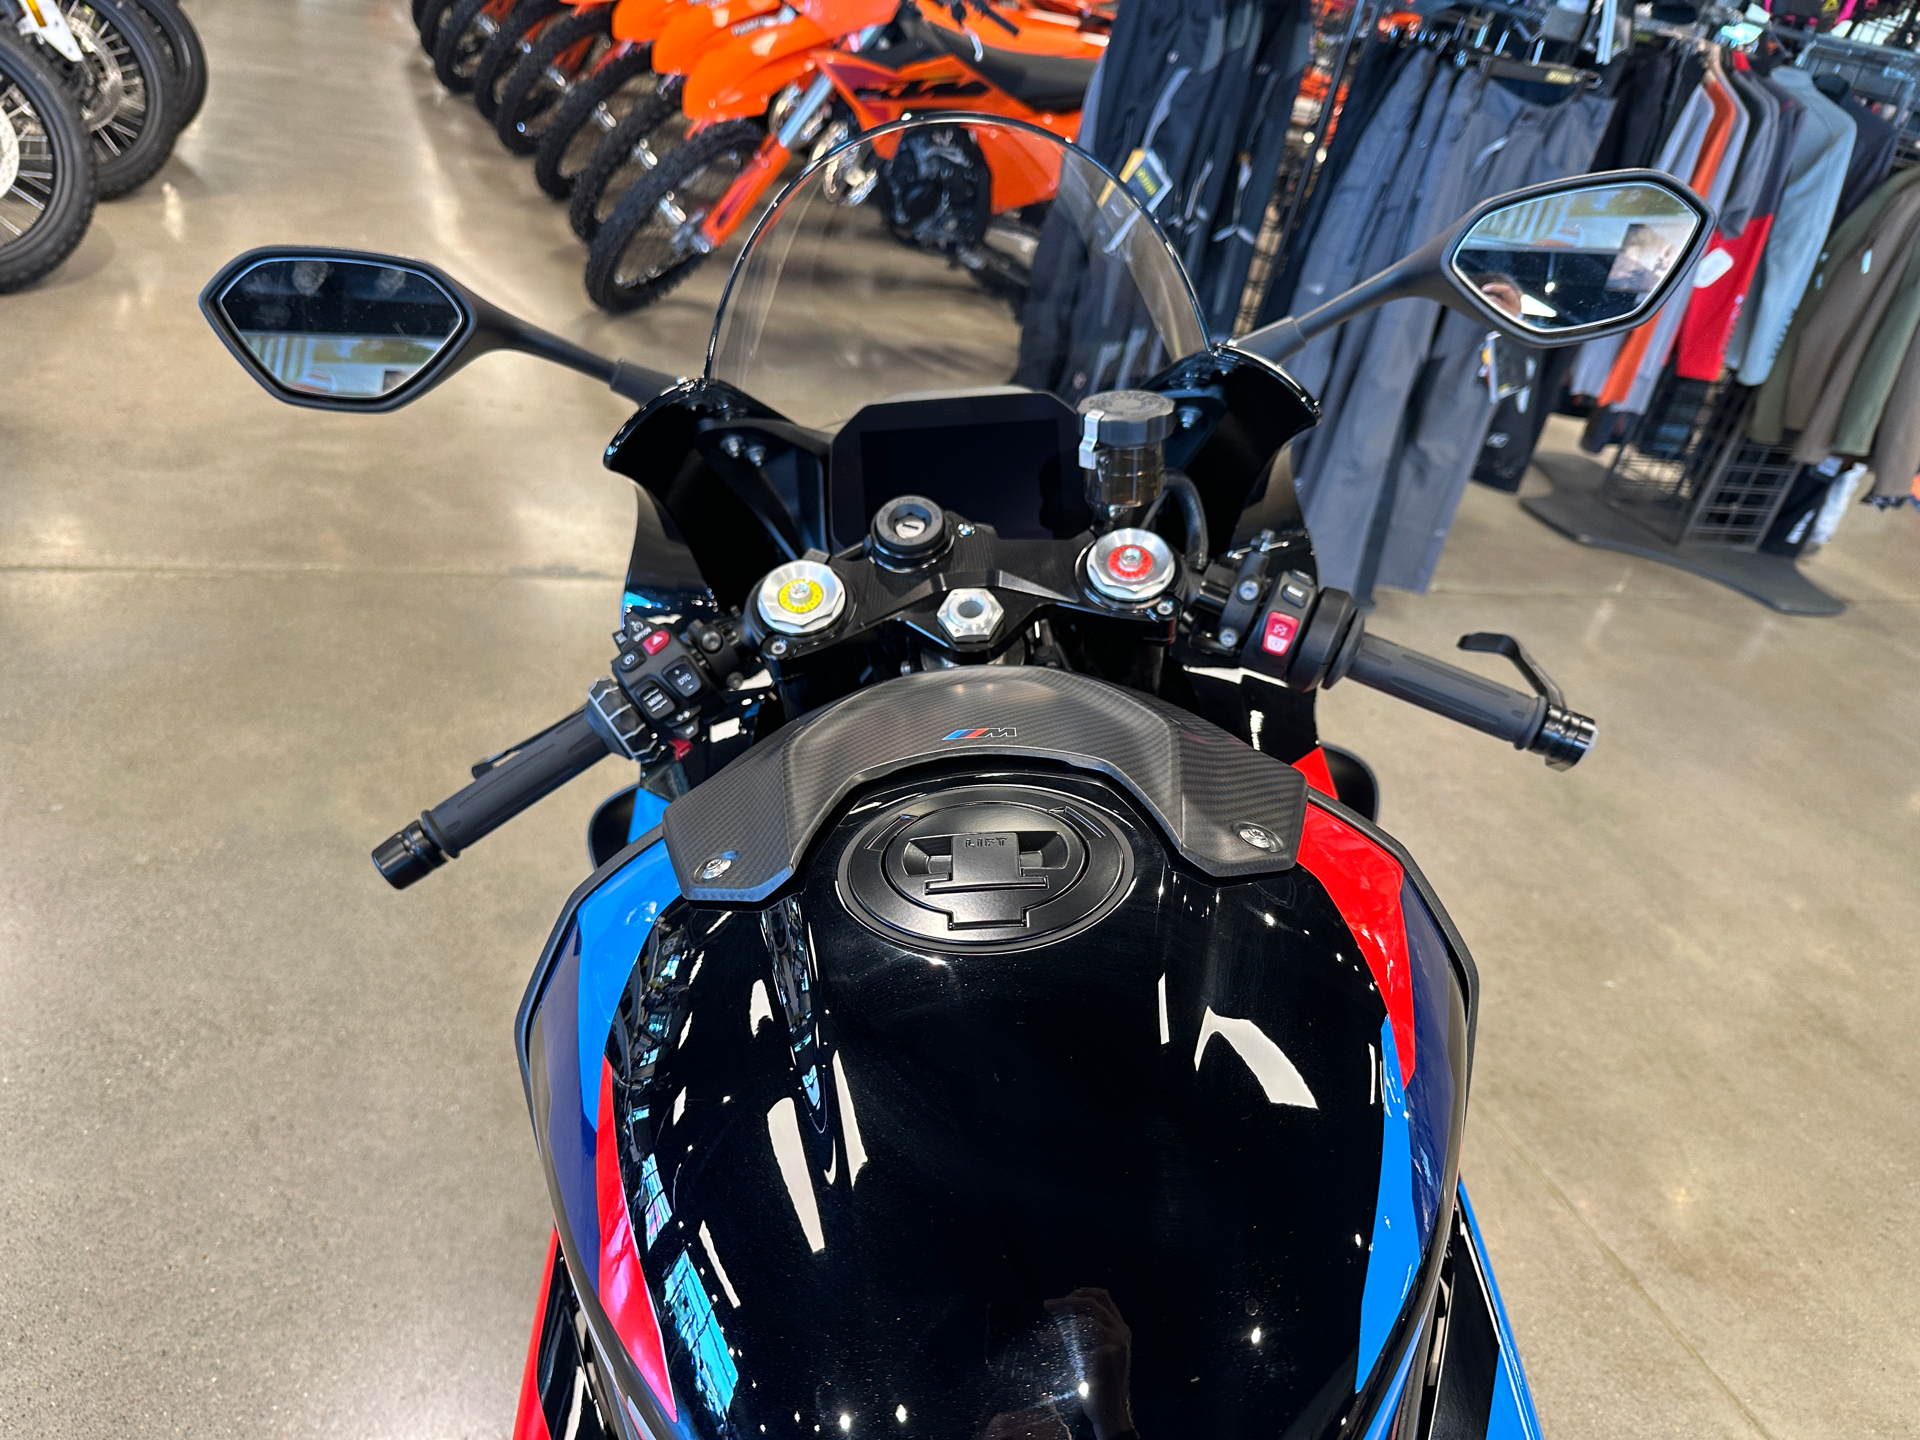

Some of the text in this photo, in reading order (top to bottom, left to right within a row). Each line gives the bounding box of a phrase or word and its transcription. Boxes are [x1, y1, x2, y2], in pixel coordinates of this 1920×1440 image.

[677, 673, 692, 686] DTC
[647, 693, 663, 707] MENU
[965, 836, 1007, 848] LIFT
